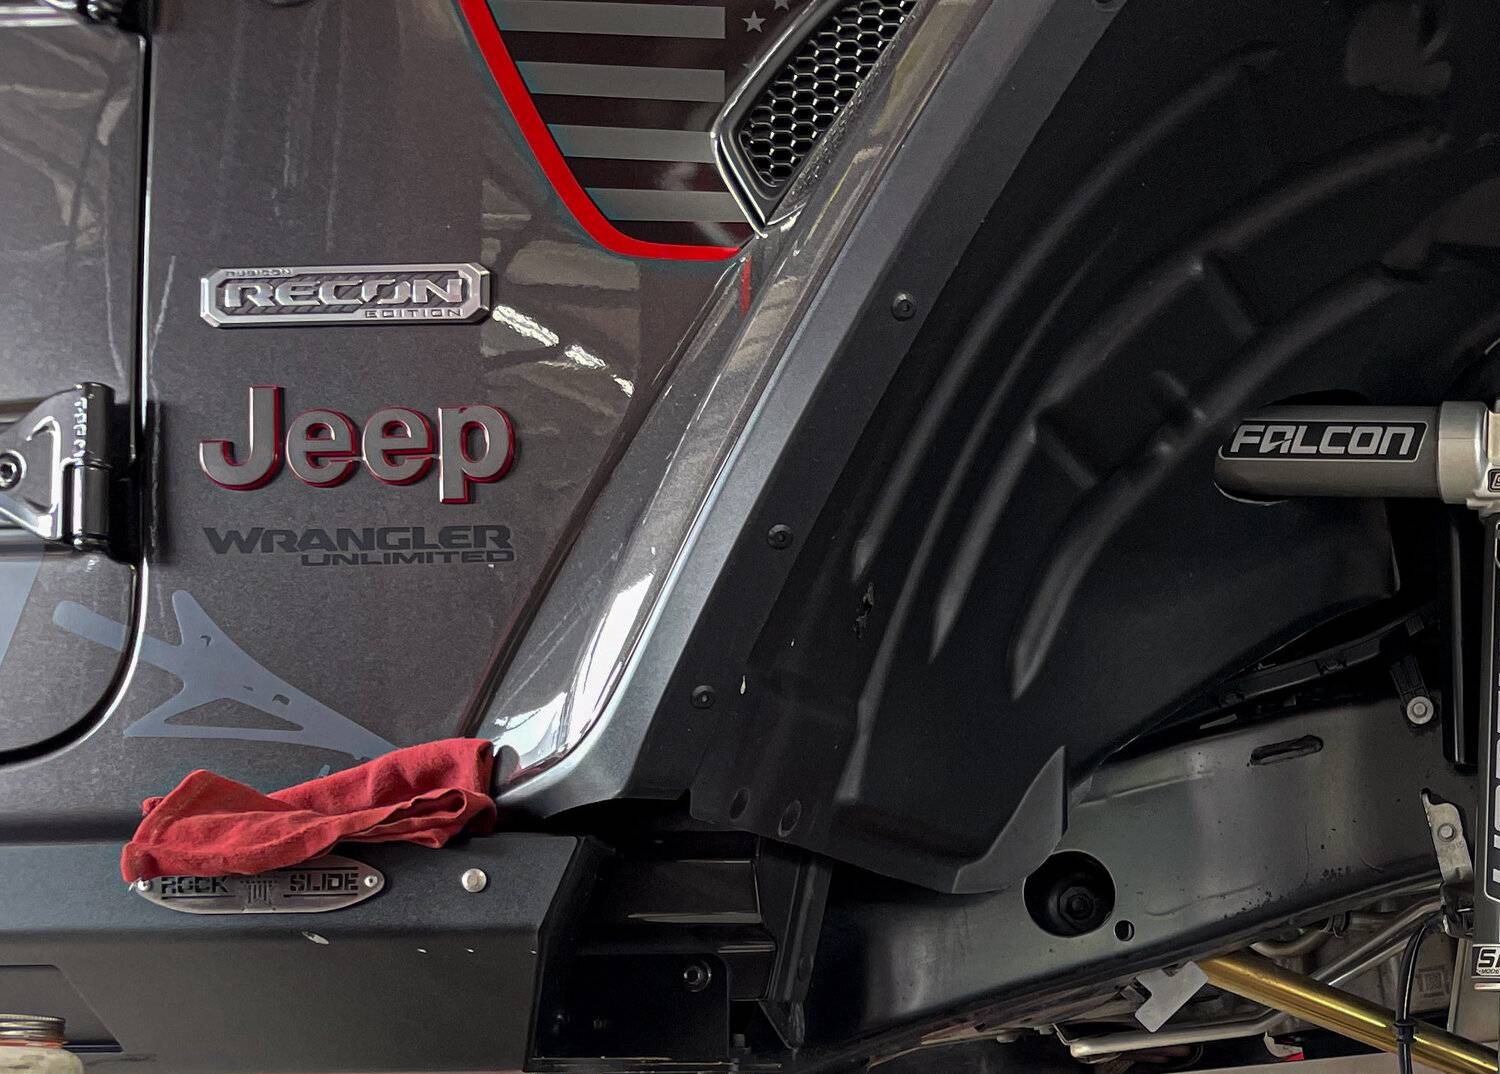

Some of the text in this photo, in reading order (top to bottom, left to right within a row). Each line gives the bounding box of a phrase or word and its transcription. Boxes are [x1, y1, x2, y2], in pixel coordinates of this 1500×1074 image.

[224, 278, 464, 308] RECON
[364, 308, 464, 319] EDITION
[199, 384, 515, 505] Jeep
[1229, 424, 1415, 455] FALCON
[202, 525, 514, 554] WRANGLER
[301, 550, 515, 566] UNLIMITED
[160, 872, 359, 895] ROCK SLIDE
